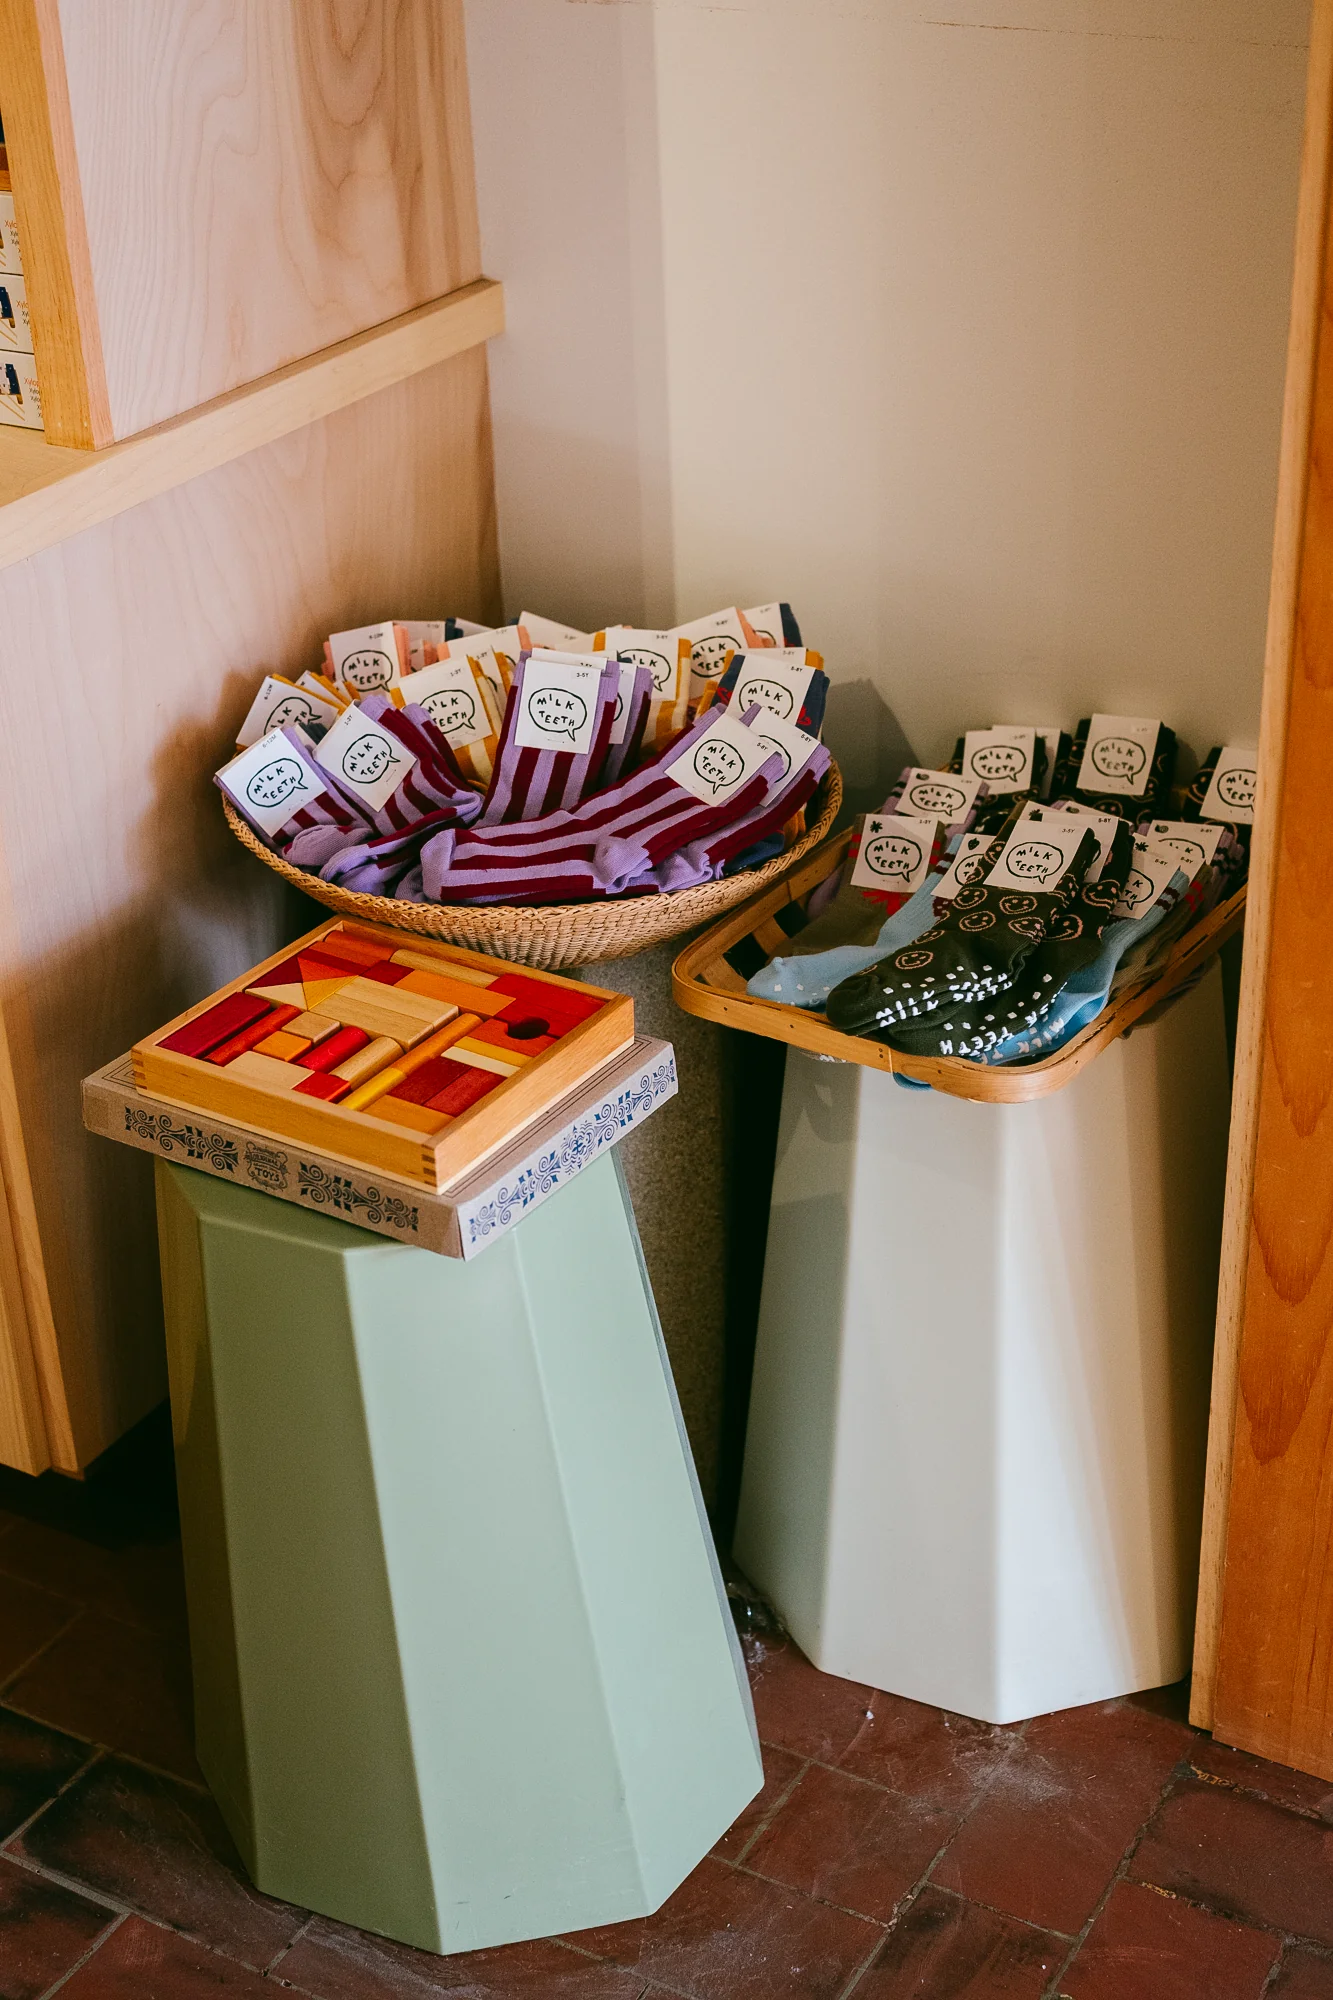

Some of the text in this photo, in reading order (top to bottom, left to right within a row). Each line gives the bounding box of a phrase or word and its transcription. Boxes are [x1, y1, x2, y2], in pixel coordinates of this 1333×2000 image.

[692, 643, 726, 660] MILK
[348, 657, 380, 671] MILK
[632, 654, 657, 667] ILK
[698, 657, 725, 671] TEET
[352, 673, 385, 684] TEETH
[748, 685, 783, 701] MILK
[427, 697, 458, 714] MILK
[537, 694, 574, 710] MILK
[748, 700, 780, 716] TTH
[271, 707, 292, 728] ILK
[539, 711, 575, 727] TEETH
[262, 734, 277, 748] 6-12M
[801, 734, 811, 743] 5-8Y
[757, 742, 768, 751] 5-8Y
[1100, 742, 1135, 757] MILK
[350, 742, 373, 772] MILK
[361, 751, 388, 775] TEETH
[707, 746, 736, 769] MILK
[979, 751, 1013, 761] MILK
[703, 756, 727, 782] TEETH
[981, 765, 1015, 774] TEETH
[1101, 758, 1134, 772] TEETH
[254, 766, 284, 794] MILK
[262, 776, 296, 799] TEETH
[918, 787, 953, 799] MILK
[919, 797, 953, 809] TEETH
[874, 841, 910, 855] MILK
[1016, 846, 1053, 861] MILK
[875, 856, 909, 870] TEETH
[1016, 861, 1049, 874] TEETH
[255, 1167, 280, 1181] TOYS
